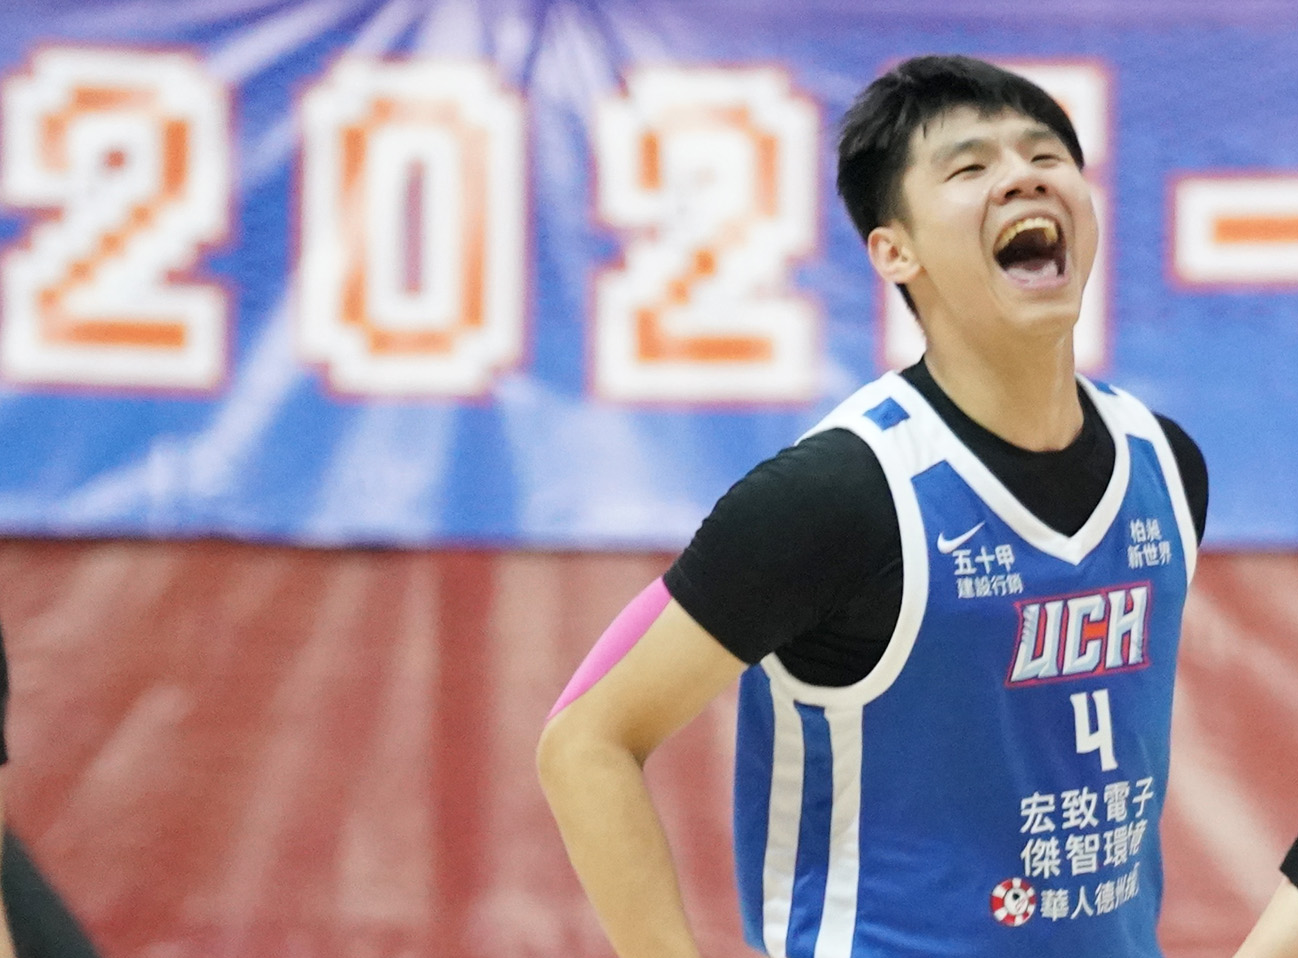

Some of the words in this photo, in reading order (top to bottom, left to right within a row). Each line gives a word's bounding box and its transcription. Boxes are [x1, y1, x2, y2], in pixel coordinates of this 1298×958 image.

[952, 544, 1016, 576] 五十甲
[1127, 541, 1172, 570] 新世界
[957, 573, 1024, 599] 建設行銷
[1008, 584, 1149, 684] UCH
[1070, 689, 1119, 771] 4
[1020, 776, 1154, 834] 宏致電子
